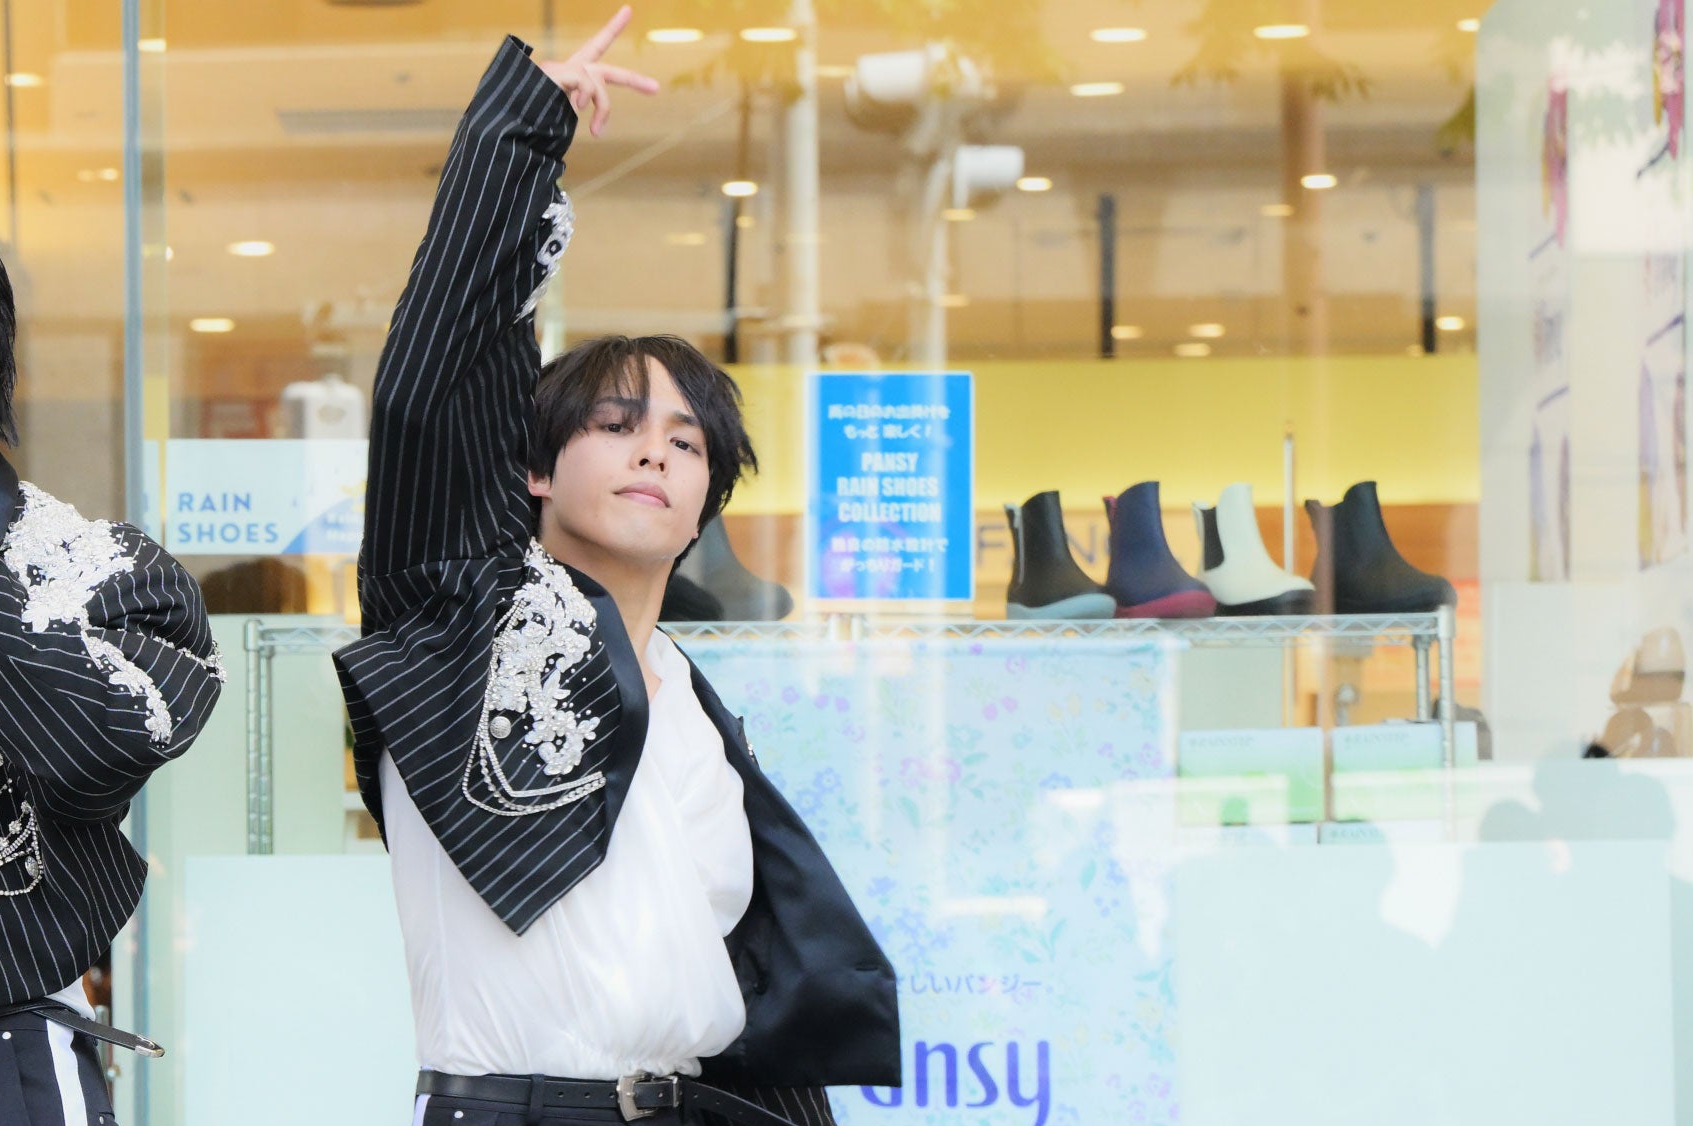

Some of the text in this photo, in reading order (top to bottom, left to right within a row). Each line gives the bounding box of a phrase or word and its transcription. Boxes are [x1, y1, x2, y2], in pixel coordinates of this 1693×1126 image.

[861, 452, 919, 472] PANSY
[837, 477, 939, 496] RAIN SHOES
[178, 493, 251, 512] RAIN
[838, 502, 942, 522] COLLECTION
[178, 523, 279, 543] SHOES
